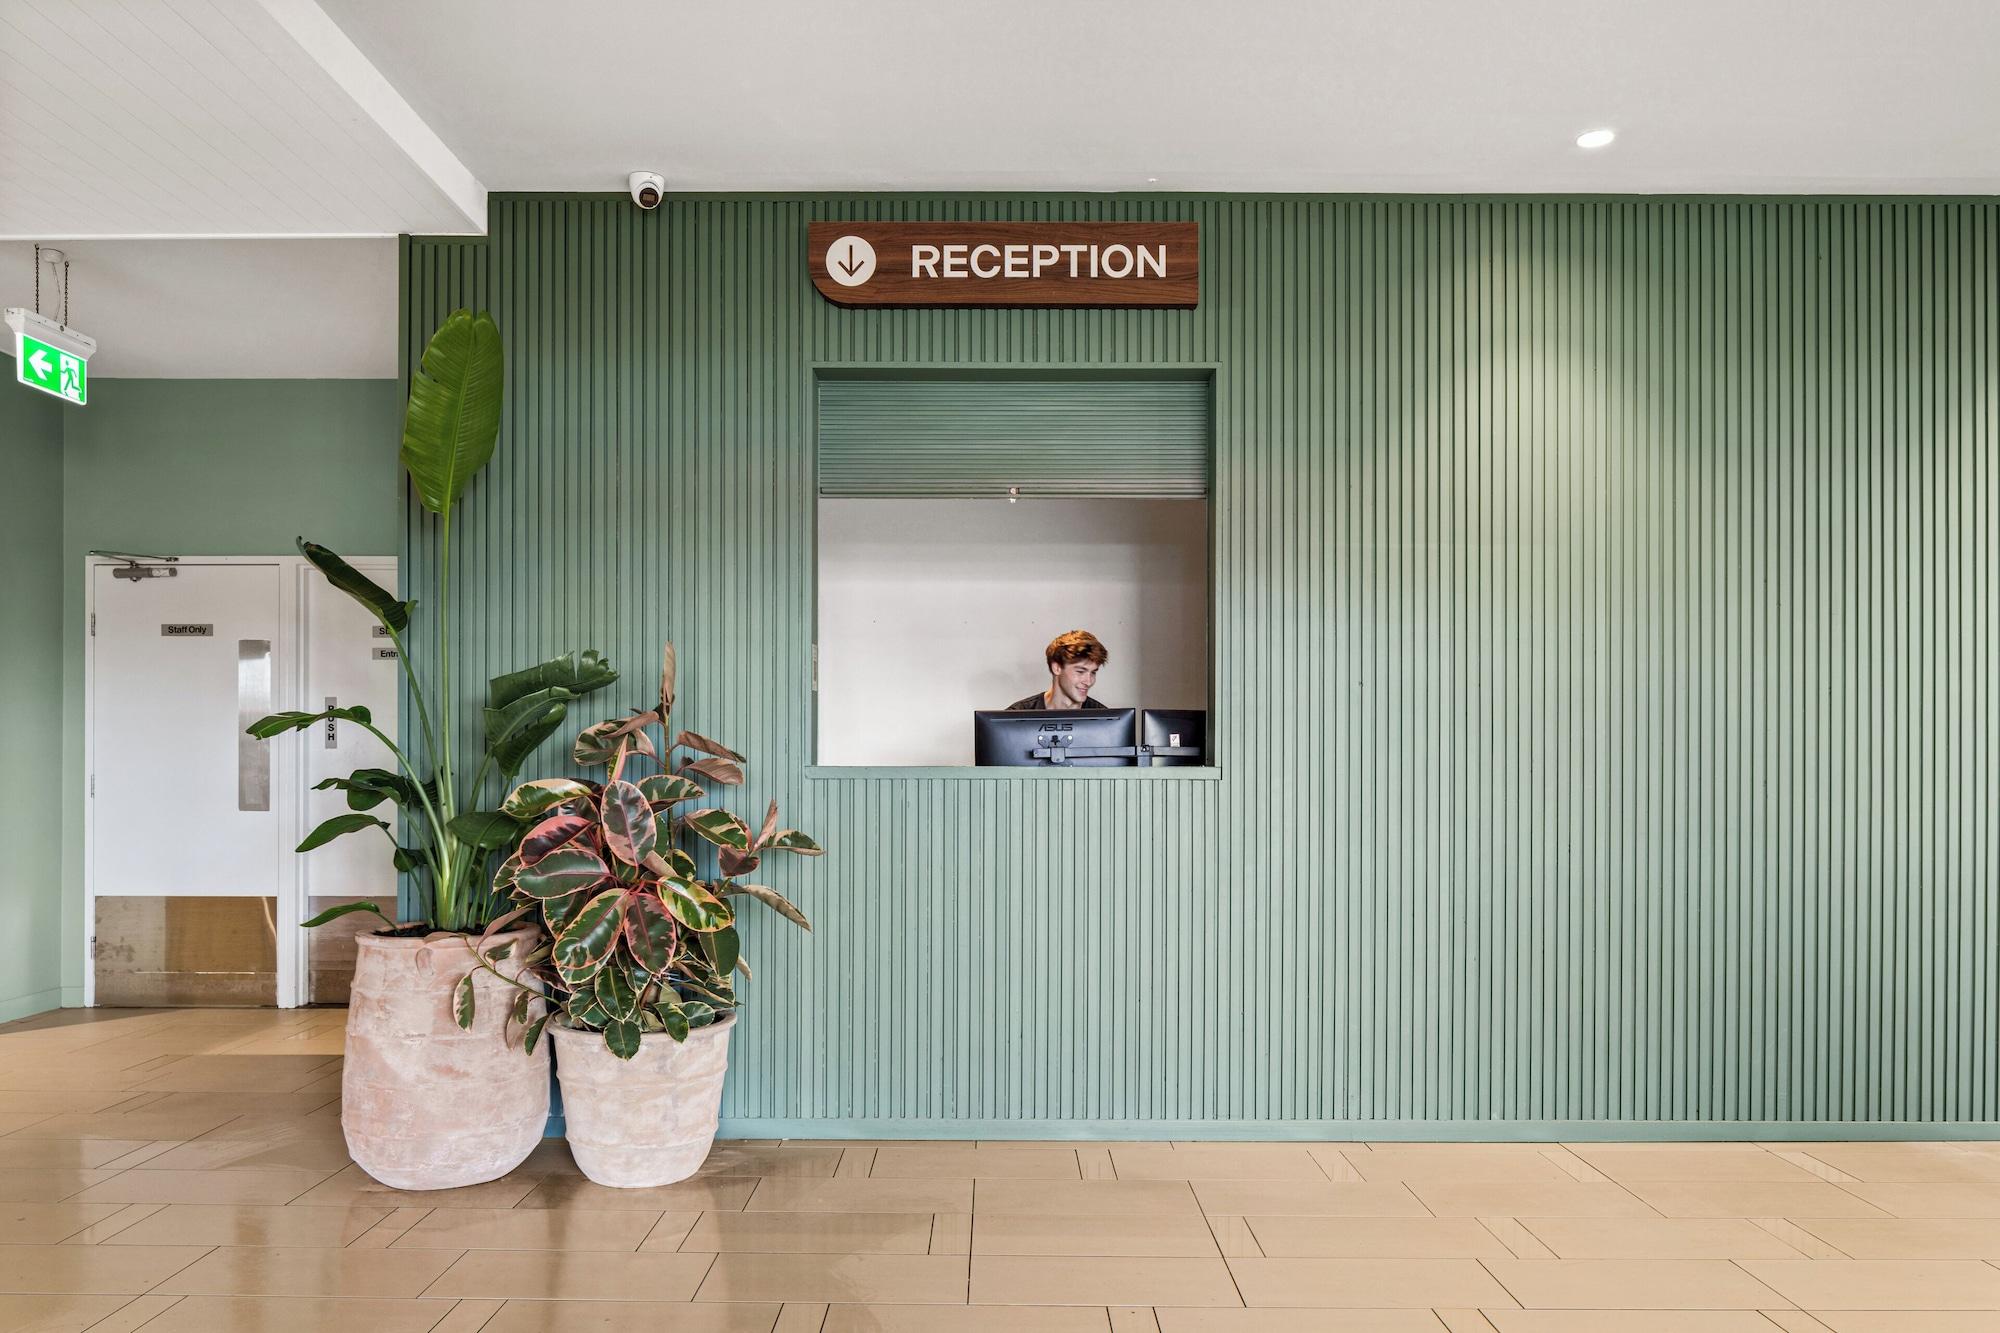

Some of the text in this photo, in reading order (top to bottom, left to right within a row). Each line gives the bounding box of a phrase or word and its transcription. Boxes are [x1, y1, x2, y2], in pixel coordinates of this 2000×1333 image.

[911, 244, 1167, 278] RECEPTION
[168, 625, 207, 635] Staff Only
[1038, 723, 1073, 732] ASUS
